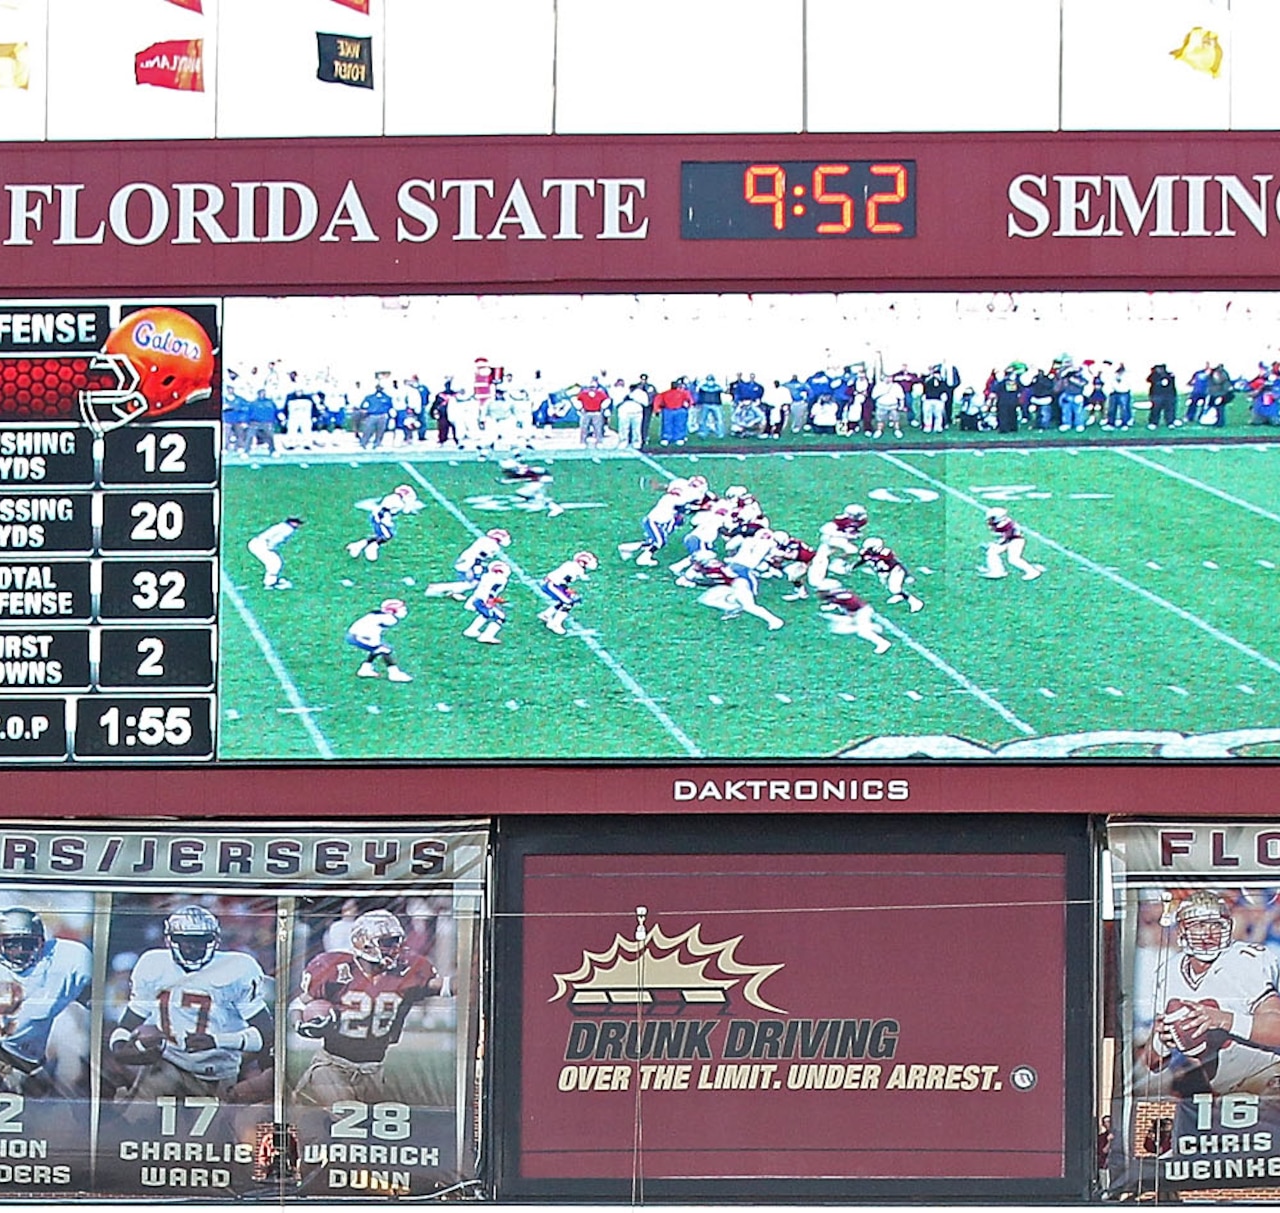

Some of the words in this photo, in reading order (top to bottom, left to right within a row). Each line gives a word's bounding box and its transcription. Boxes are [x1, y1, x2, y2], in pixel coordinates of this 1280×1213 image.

[2, 180, 380, 247] FLORIDA
[395, 177, 651, 243] STATE
[743, 163, 907, 234] 9:52
[133, 321, 203, 362] Gators
[135, 433, 187, 473] 12
[129, 501, 184, 541] 20
[131, 570, 186, 610] 32
[136, 637, 164, 676] 2
[99, 706, 193, 747] 1:55
[672, 778, 911, 802] DAKTRONICS
[564, 1019, 718, 1061] DRUNK
[723, 1017, 901, 1060] DRIVING
[557, 1064, 631, 1092] OVER
[638, 1064, 690, 1091] THE
[698, 1064, 783, 1091] LIMIT.
[786, 1064, 881, 1091] UNDER
[886, 1064, 1004, 1092] ARREST.
[156, 1096, 220, 1136] 17
[329, 1102, 412, 1141] 28
[1191, 1092, 1261, 1130] 16
[119, 1140, 254, 1163] CHARLIE
[303, 1144, 440, 1167] WARRICK
[1178, 1131, 1274, 1155] CHRIS
[140, 1166, 231, 1188] WARD
[328, 1168, 412, 1192] DUNN
